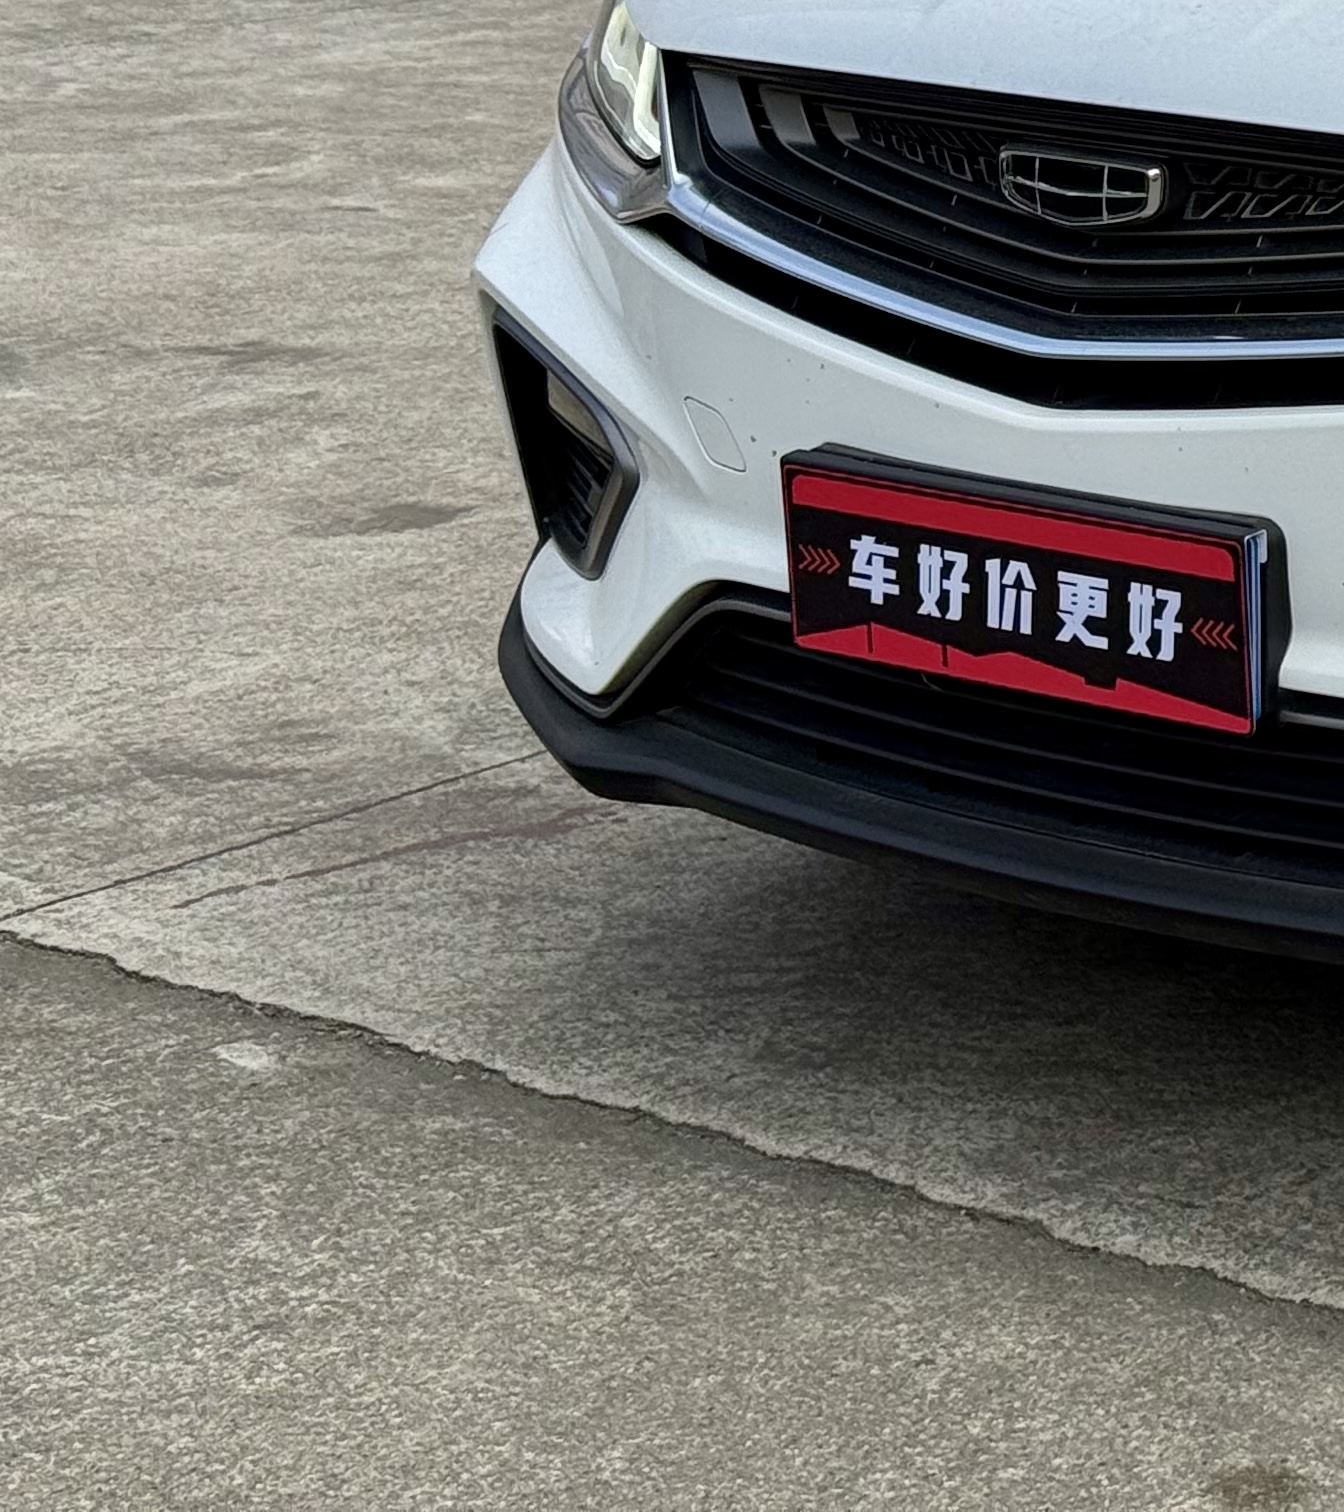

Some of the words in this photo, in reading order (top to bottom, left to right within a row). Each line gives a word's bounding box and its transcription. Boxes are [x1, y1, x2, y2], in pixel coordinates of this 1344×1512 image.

[848, 534, 1183, 662] 车好价更好
